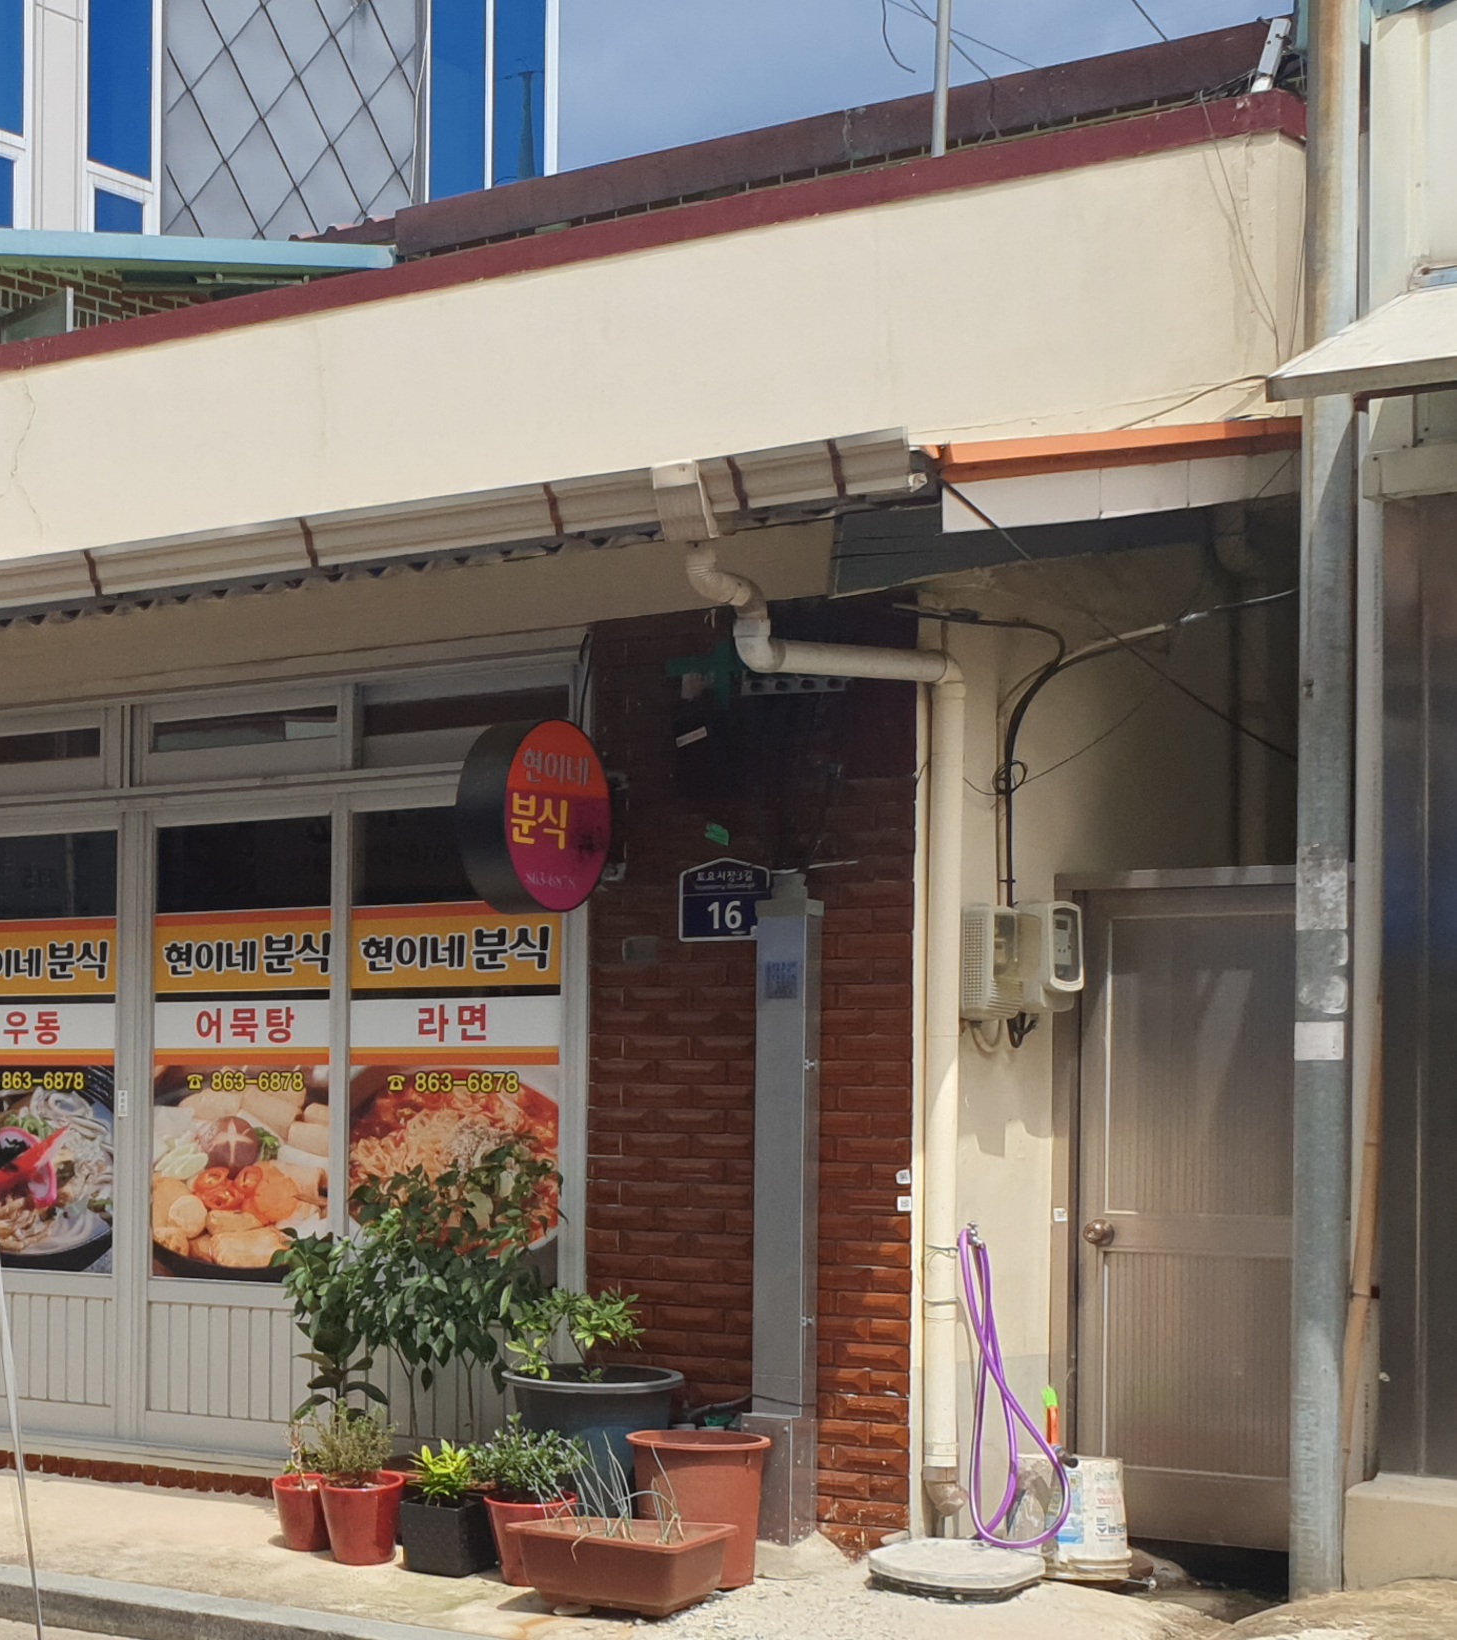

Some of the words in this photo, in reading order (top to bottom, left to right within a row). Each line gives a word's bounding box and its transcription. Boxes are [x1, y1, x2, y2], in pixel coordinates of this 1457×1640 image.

[523, 748, 591, 787] 현이네
[510, 792, 570, 851] 분식
[706, 900, 743, 930] 16
[47, 940, 109, 980] 분식
[164, 940, 257, 976] 현이네
[263, 932, 331, 973] 분식
[361, 934, 466, 972] 현이네
[472, 925, 551, 970] 분식
[3, 1010, 61, 1046] 우동
[195, 1006, 295, 1044] 어묵탕
[417, 1003, 488, 1043] 라면
[1, 1071, 85, 1091] 863-6878
[210, 1071, 305, 1092] 863-6878
[414, 1071, 520, 1093] 863-6878
